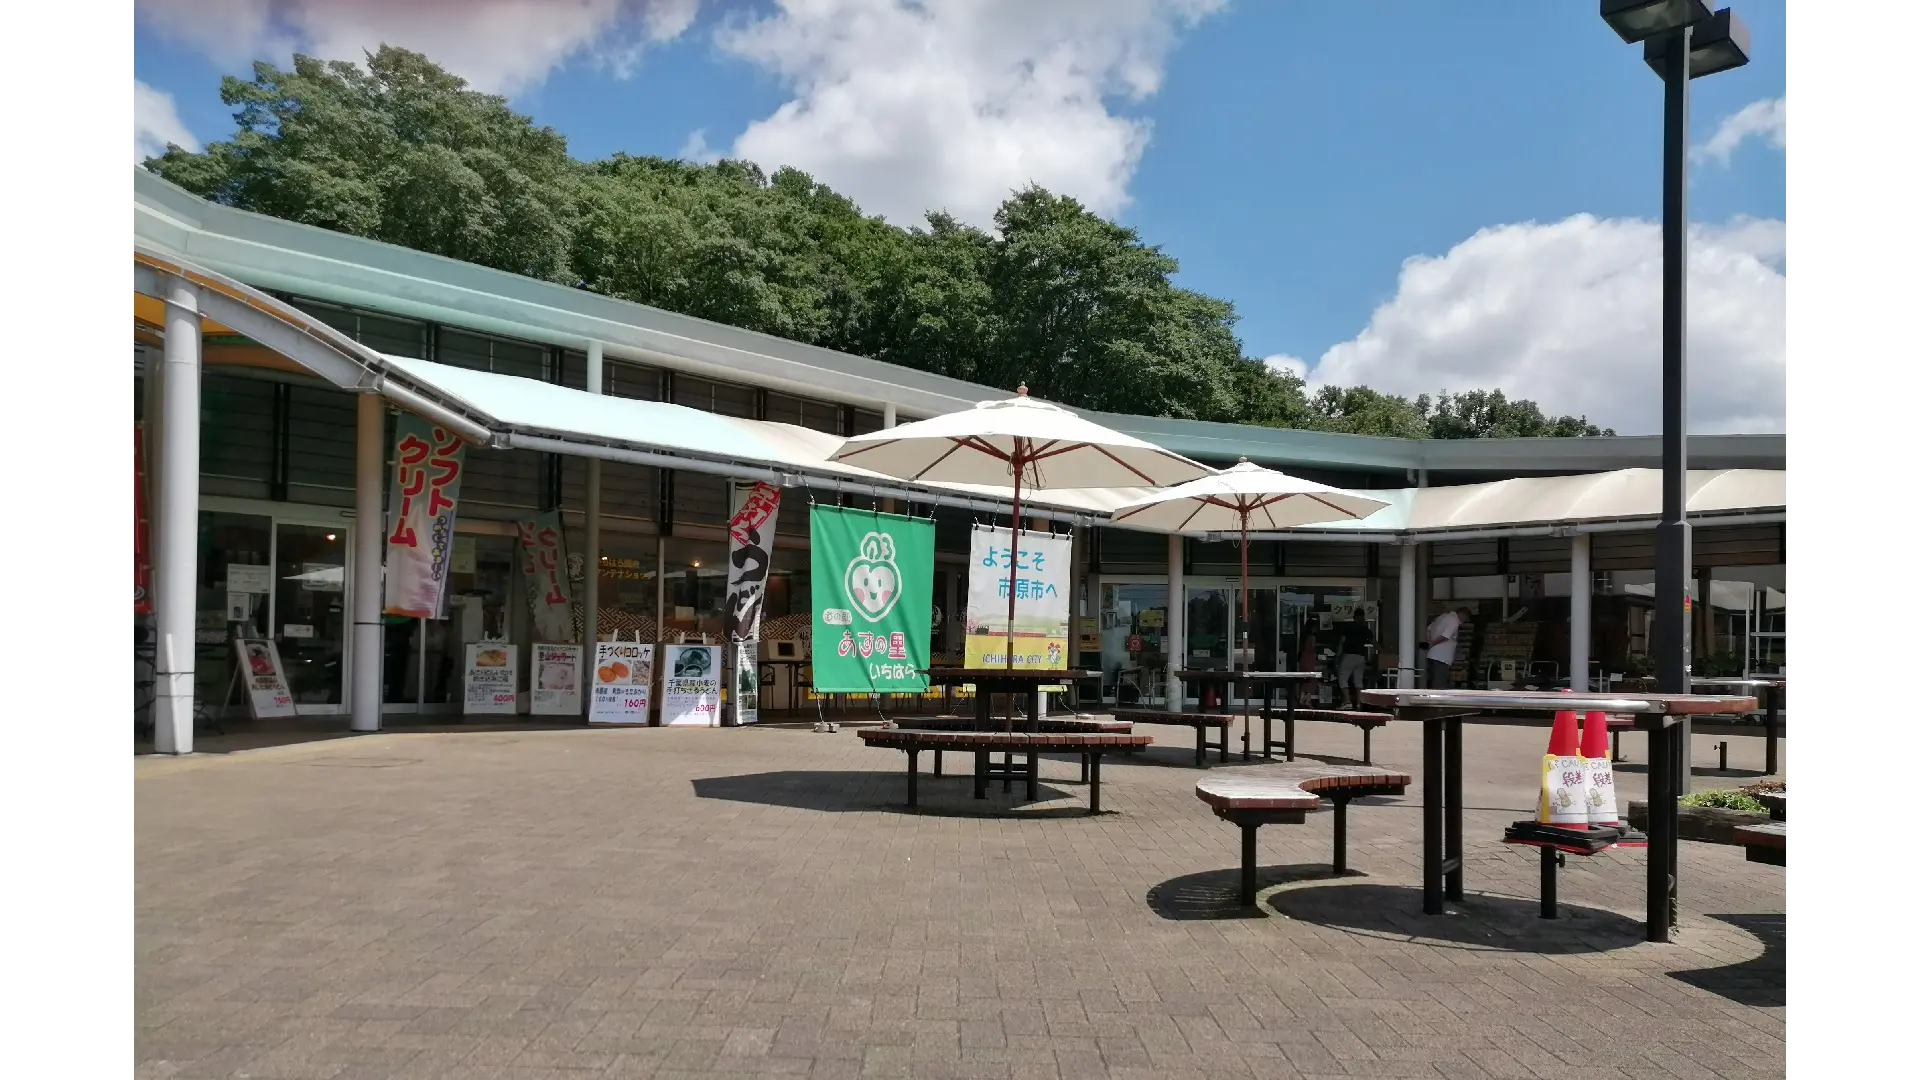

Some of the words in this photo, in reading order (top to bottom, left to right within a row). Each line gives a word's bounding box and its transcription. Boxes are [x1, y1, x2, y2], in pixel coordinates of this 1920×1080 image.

[390, 435, 429, 547] クリーム
[983, 546, 1045, 571] ようこそ
[999, 577, 1058, 600] 市原市へ
[1333, 605, 1374, 615] クワタ
[599, 645, 651, 658] 手づくりコロッケ
[982, 654, 1024, 664] ICHIHRA
[1026, 655, 1042, 664] CITY
[869, 663, 917, 680] いちはら
[624, 699, 646, 708] 160円
